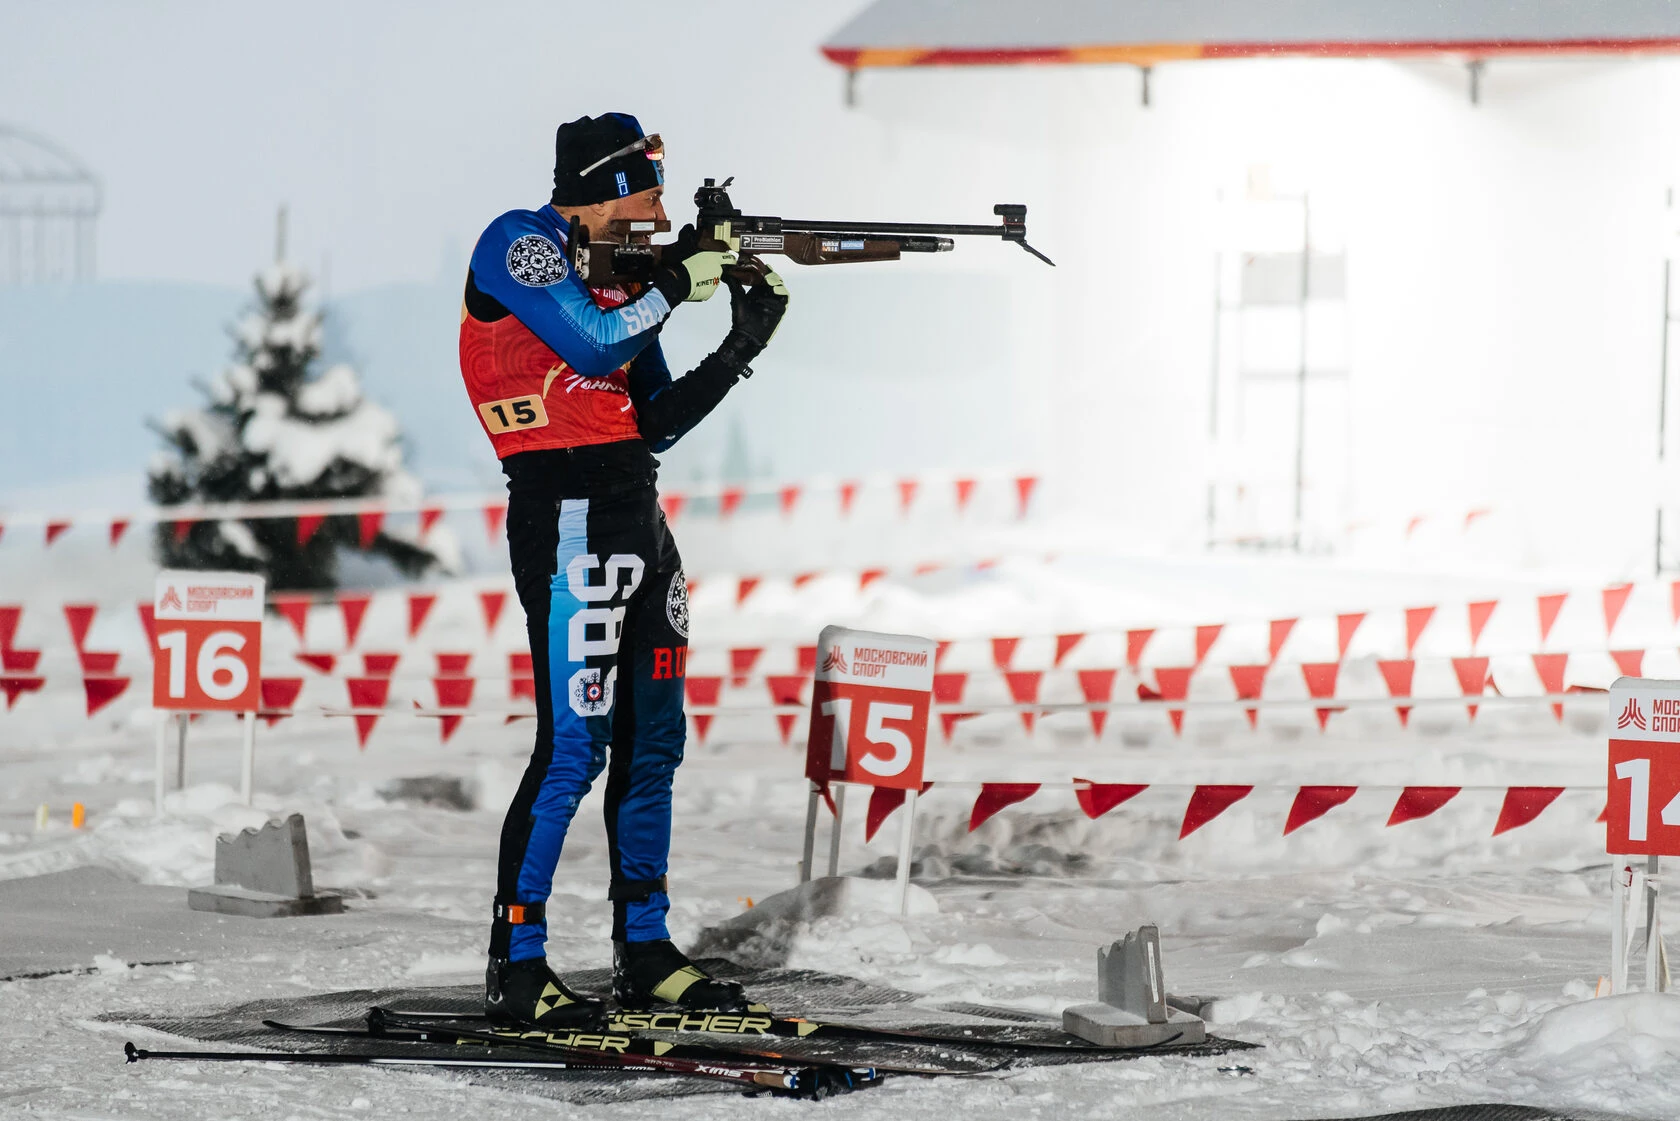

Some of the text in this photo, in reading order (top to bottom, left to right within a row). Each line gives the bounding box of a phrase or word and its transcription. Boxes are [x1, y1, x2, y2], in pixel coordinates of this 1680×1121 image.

[490, 400, 537, 427] 15
[157, 630, 249, 701] 16
[853, 647, 928, 668] МОСКОВСКИЙ
[852, 662, 887, 679] СПОРТ
[820, 697, 914, 777] 15
[694, 1064, 744, 1078] SWIX
